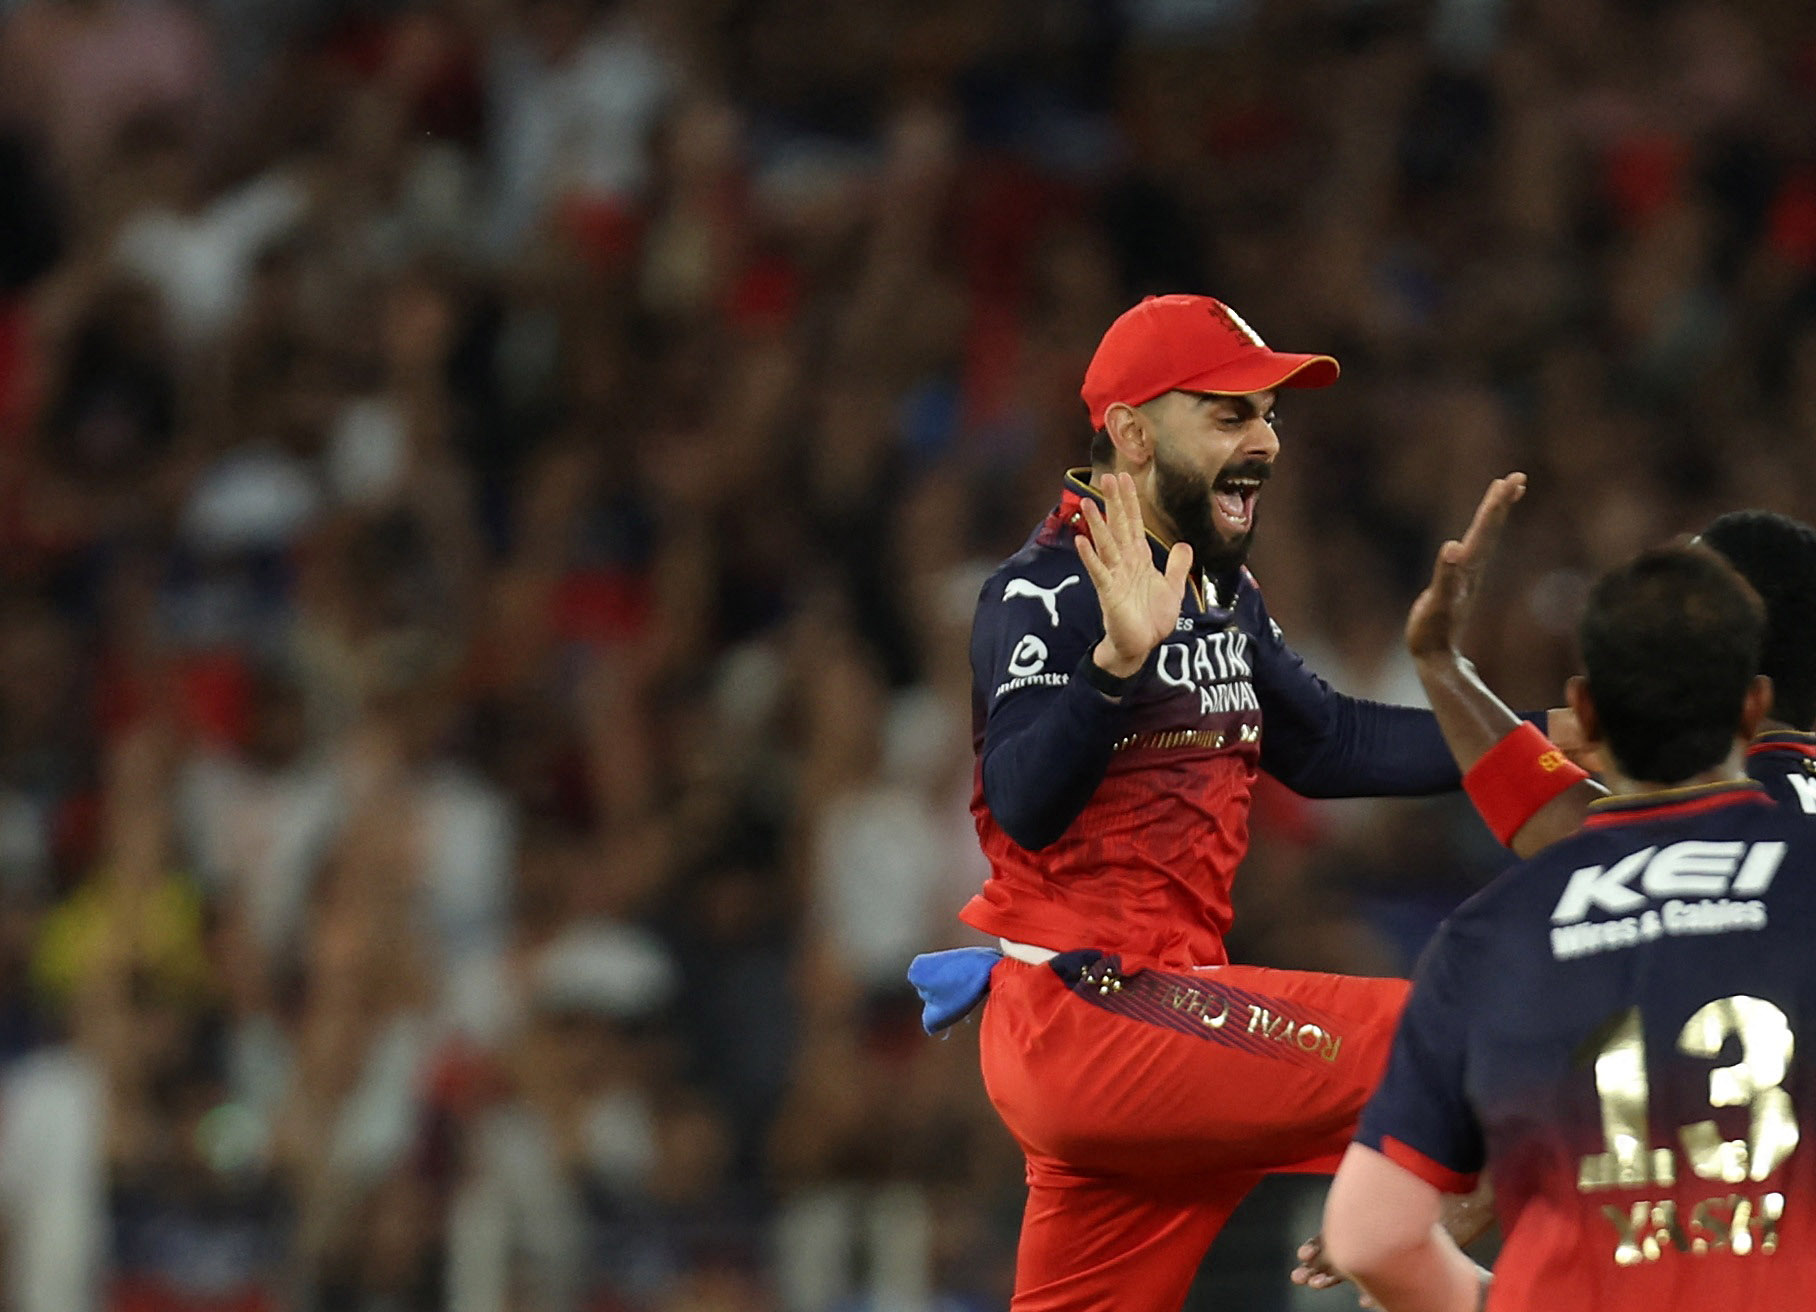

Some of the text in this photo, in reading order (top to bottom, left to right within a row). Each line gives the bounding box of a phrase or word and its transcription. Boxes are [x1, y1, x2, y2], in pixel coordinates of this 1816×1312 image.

[1157, 631, 1252, 692] QATAR
[1551, 840, 1787, 926] KEI
[1248, 1004, 1342, 1062] ROYAL
[1577, 995, 1800, 1193] 13
[1601, 1192, 1785, 1265] YASH
